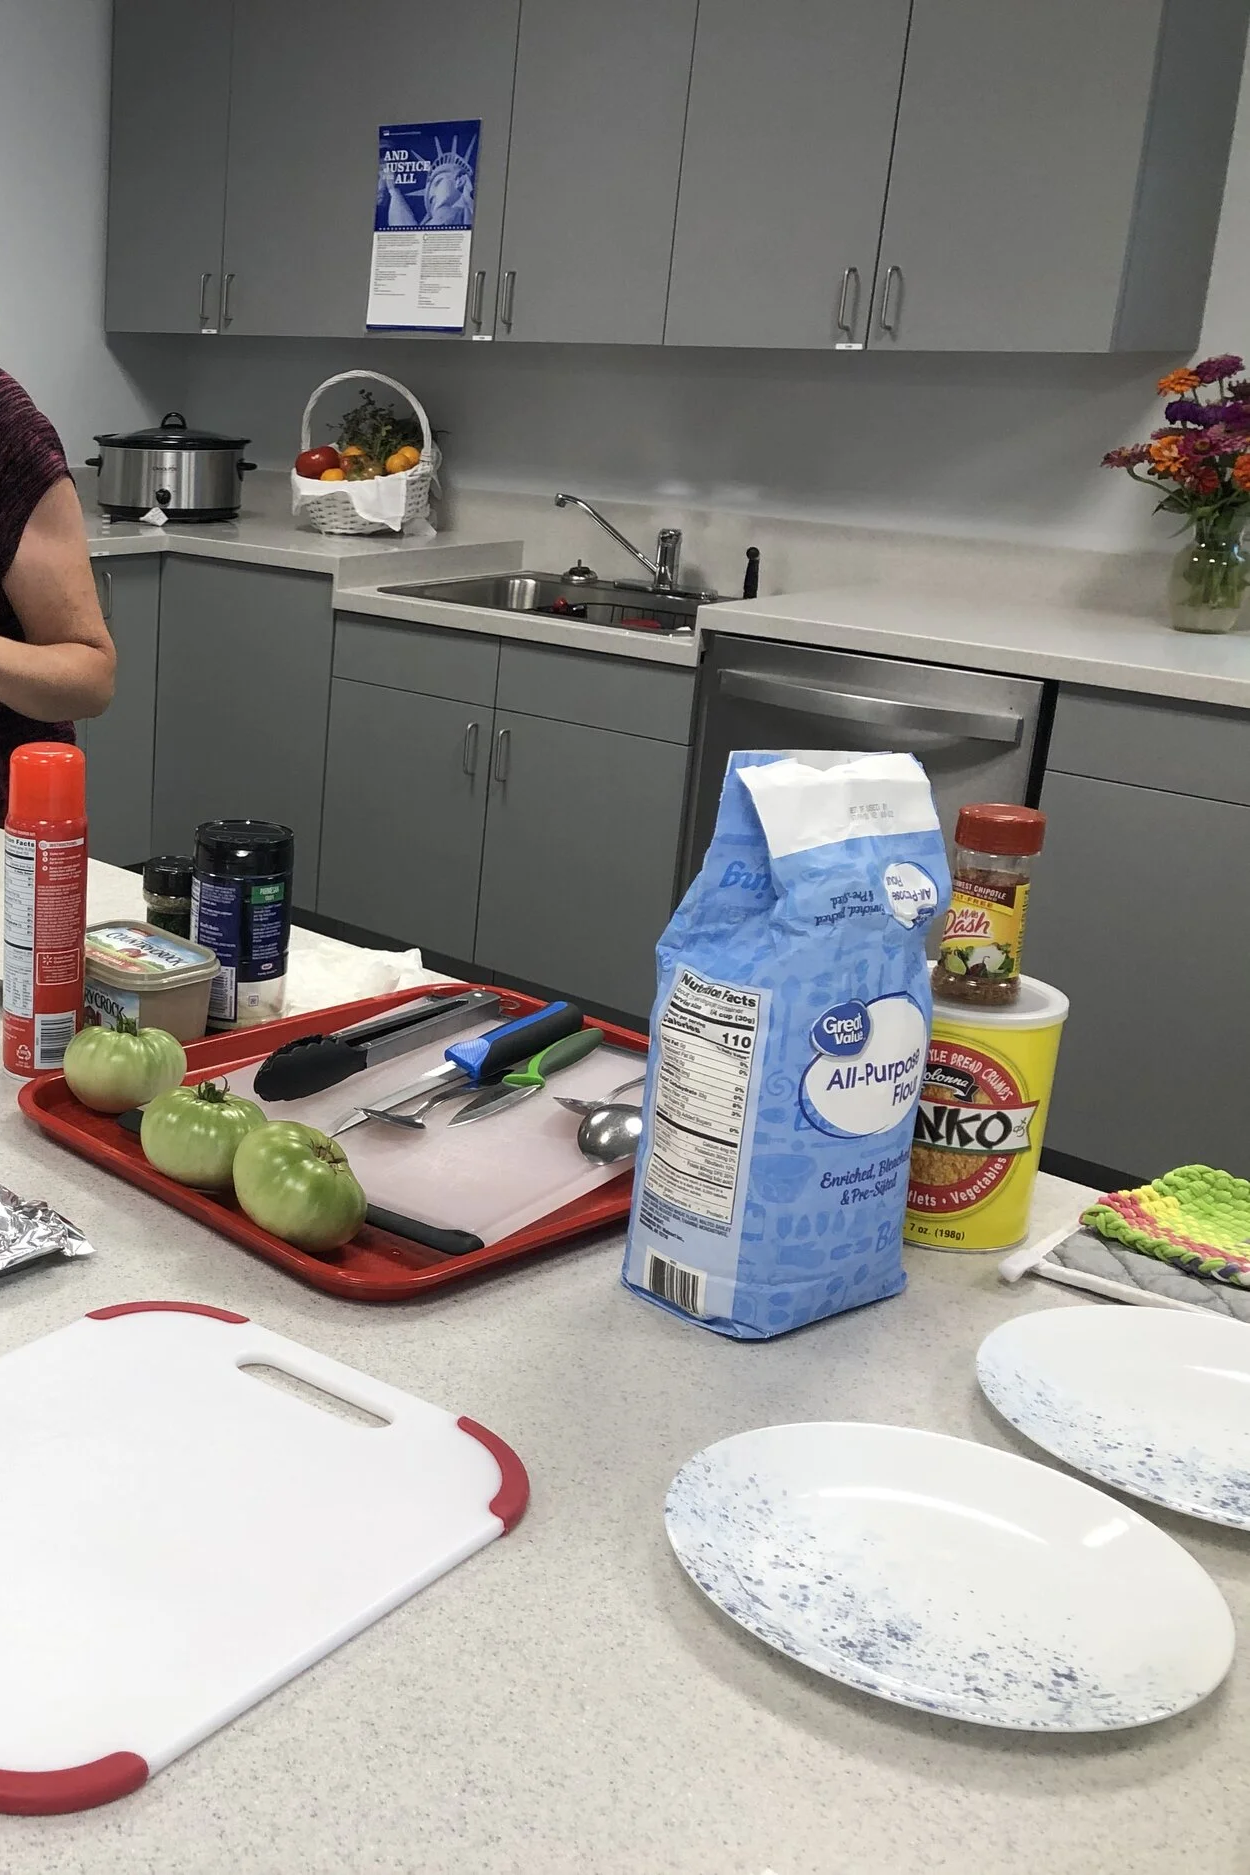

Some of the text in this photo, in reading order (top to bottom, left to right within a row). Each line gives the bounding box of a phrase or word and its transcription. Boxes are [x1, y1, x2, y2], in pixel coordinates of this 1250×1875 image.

[384, 150, 409, 161] AND
[383, 161, 431, 173] JUSTICE
[395, 174, 417, 184] ALL
[973, 885, 1007, 900] CHIPOTLE
[681, 973, 757, 1008] Nutrition Facts
[822, 1012, 864, 1035] Great
[722, 1032, 752, 1049] 110
[834, 1030, 864, 1045] Value
[825, 1048, 921, 1091] All-Purpose
[924, 1067, 969, 1088] olonna
[928, 1048, 1015, 1102] YLE BREAD CRUMBS
[912, 1105, 1013, 1149] NKO
[820, 1163, 876, 1189] Enriched,
[950, 1156, 1007, 1205] Vegetables
[840, 1189, 849, 1206] &
[909, 1222, 966, 1241] 7 oz. (198g)
